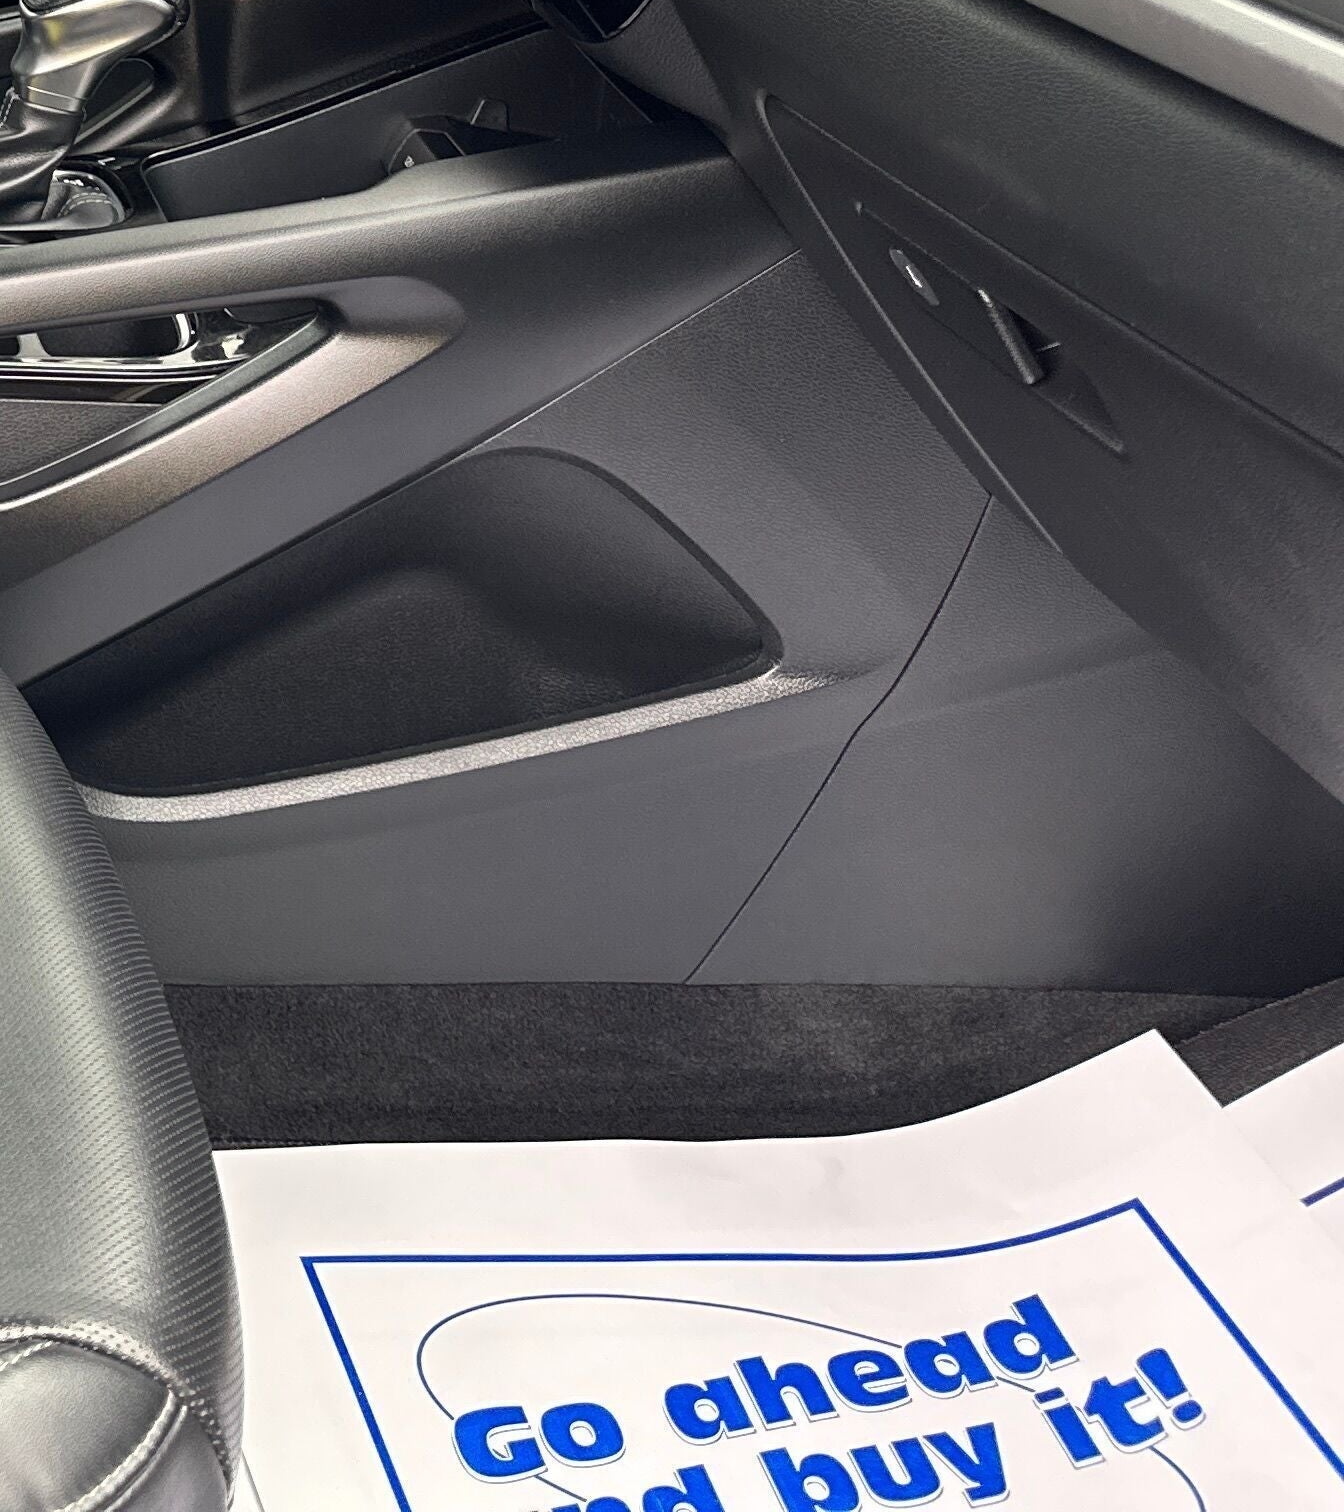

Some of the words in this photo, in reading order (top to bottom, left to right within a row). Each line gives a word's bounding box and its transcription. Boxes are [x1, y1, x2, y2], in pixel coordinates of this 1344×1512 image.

[452, 1402, 626, 1483] Go
[663, 1294, 1079, 1446] ahead
[758, 1422, 1010, 1512] buy
[1034, 1347, 1205, 1469] it!
